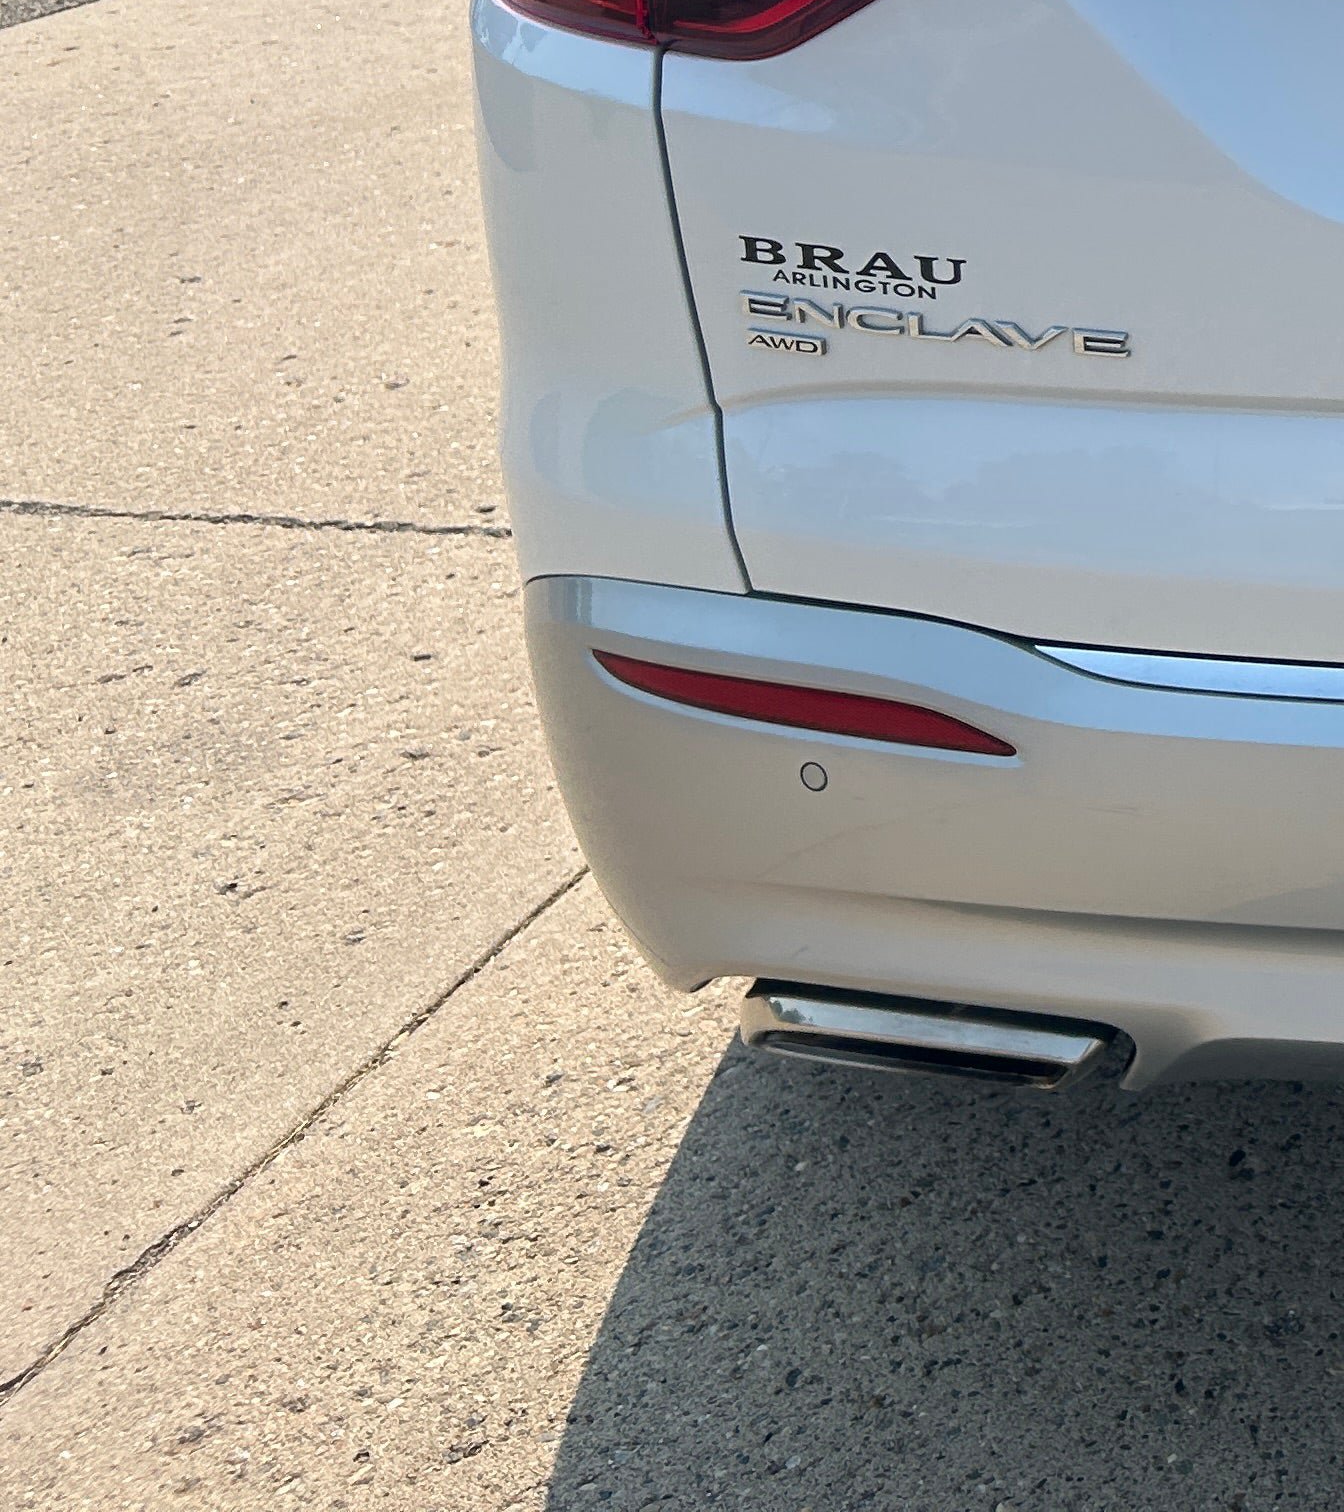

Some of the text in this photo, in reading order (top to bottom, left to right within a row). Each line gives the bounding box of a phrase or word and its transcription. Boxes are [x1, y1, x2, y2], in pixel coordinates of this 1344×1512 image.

[739, 235, 967, 285] BRAU
[773, 269, 937, 300] ARLINGTON
[739, 289, 1132, 358] ENCLAVE
[748, 333, 819, 355] AWD
